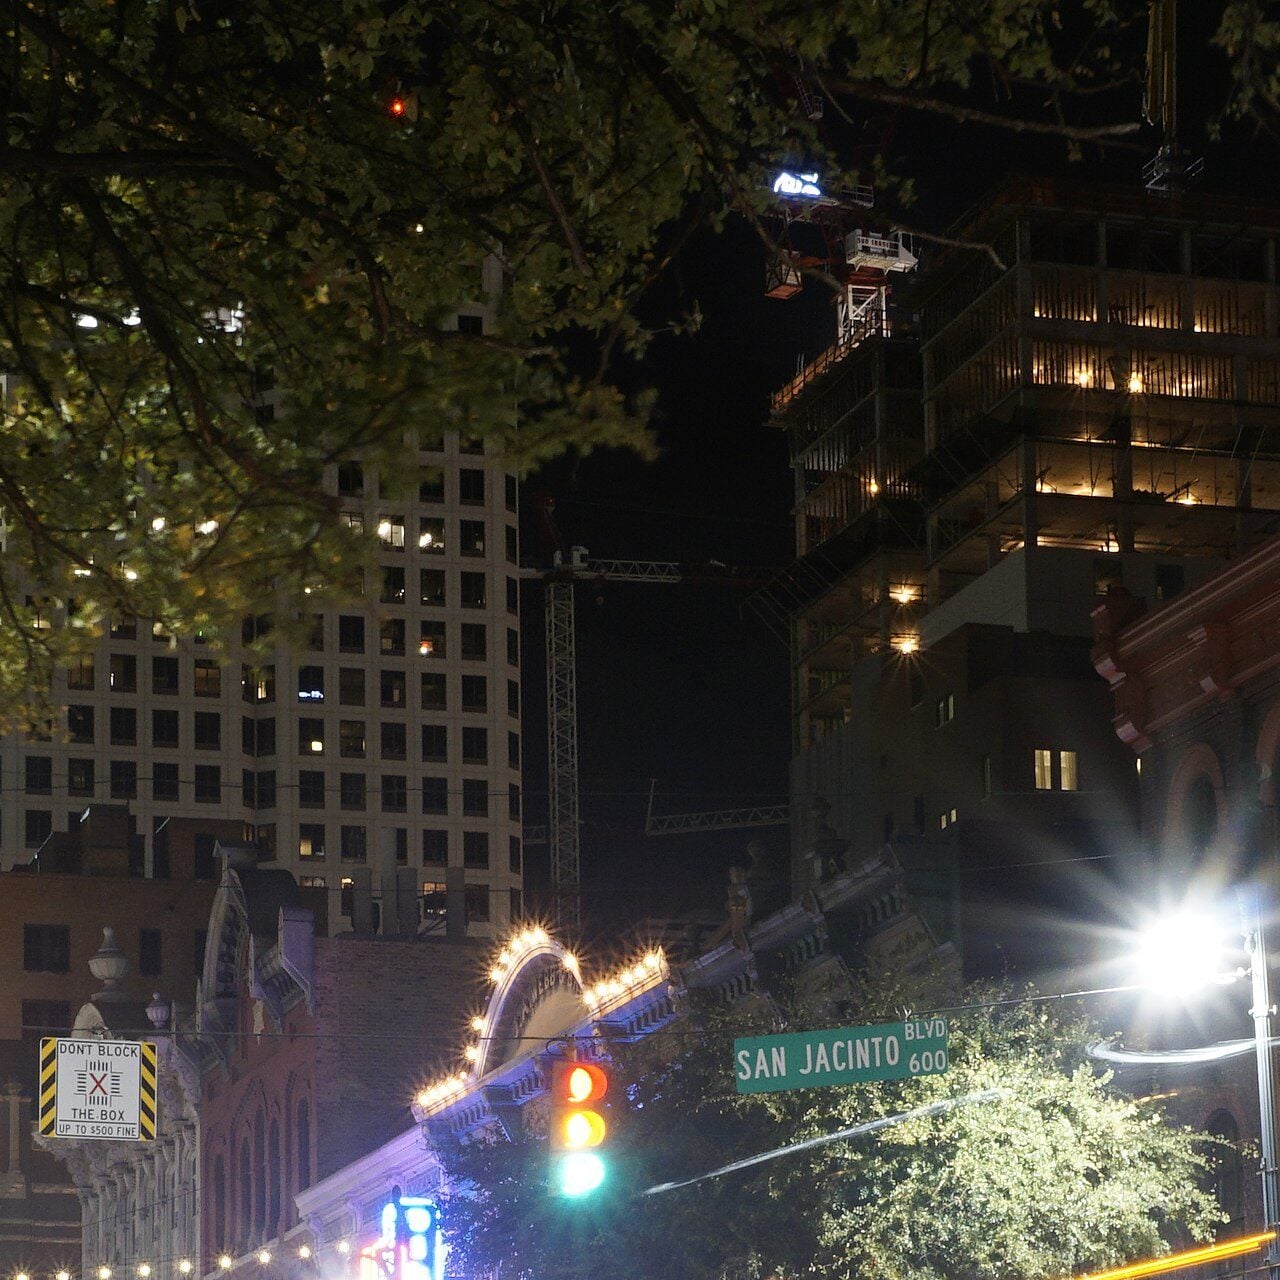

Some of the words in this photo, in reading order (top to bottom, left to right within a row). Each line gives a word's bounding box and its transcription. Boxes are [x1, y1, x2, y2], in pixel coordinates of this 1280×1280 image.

[904, 1019, 946, 1041] BLVD
[60, 1043, 93, 1056] DON'T
[98, 1045, 138, 1058] BLOCK
[737, 1046, 787, 1081] SAN
[798, 1035, 900, 1075] JACINTO
[908, 1050, 947, 1074] 600
[72, 1108, 97, 1121] THE
[100, 1109, 125, 1121] BOX
[59, 1123, 71, 1134] UP
[76, 1124, 87, 1134] TO
[91, 1125, 113, 1135] $500
[117, 1126, 137, 1136] FINE
